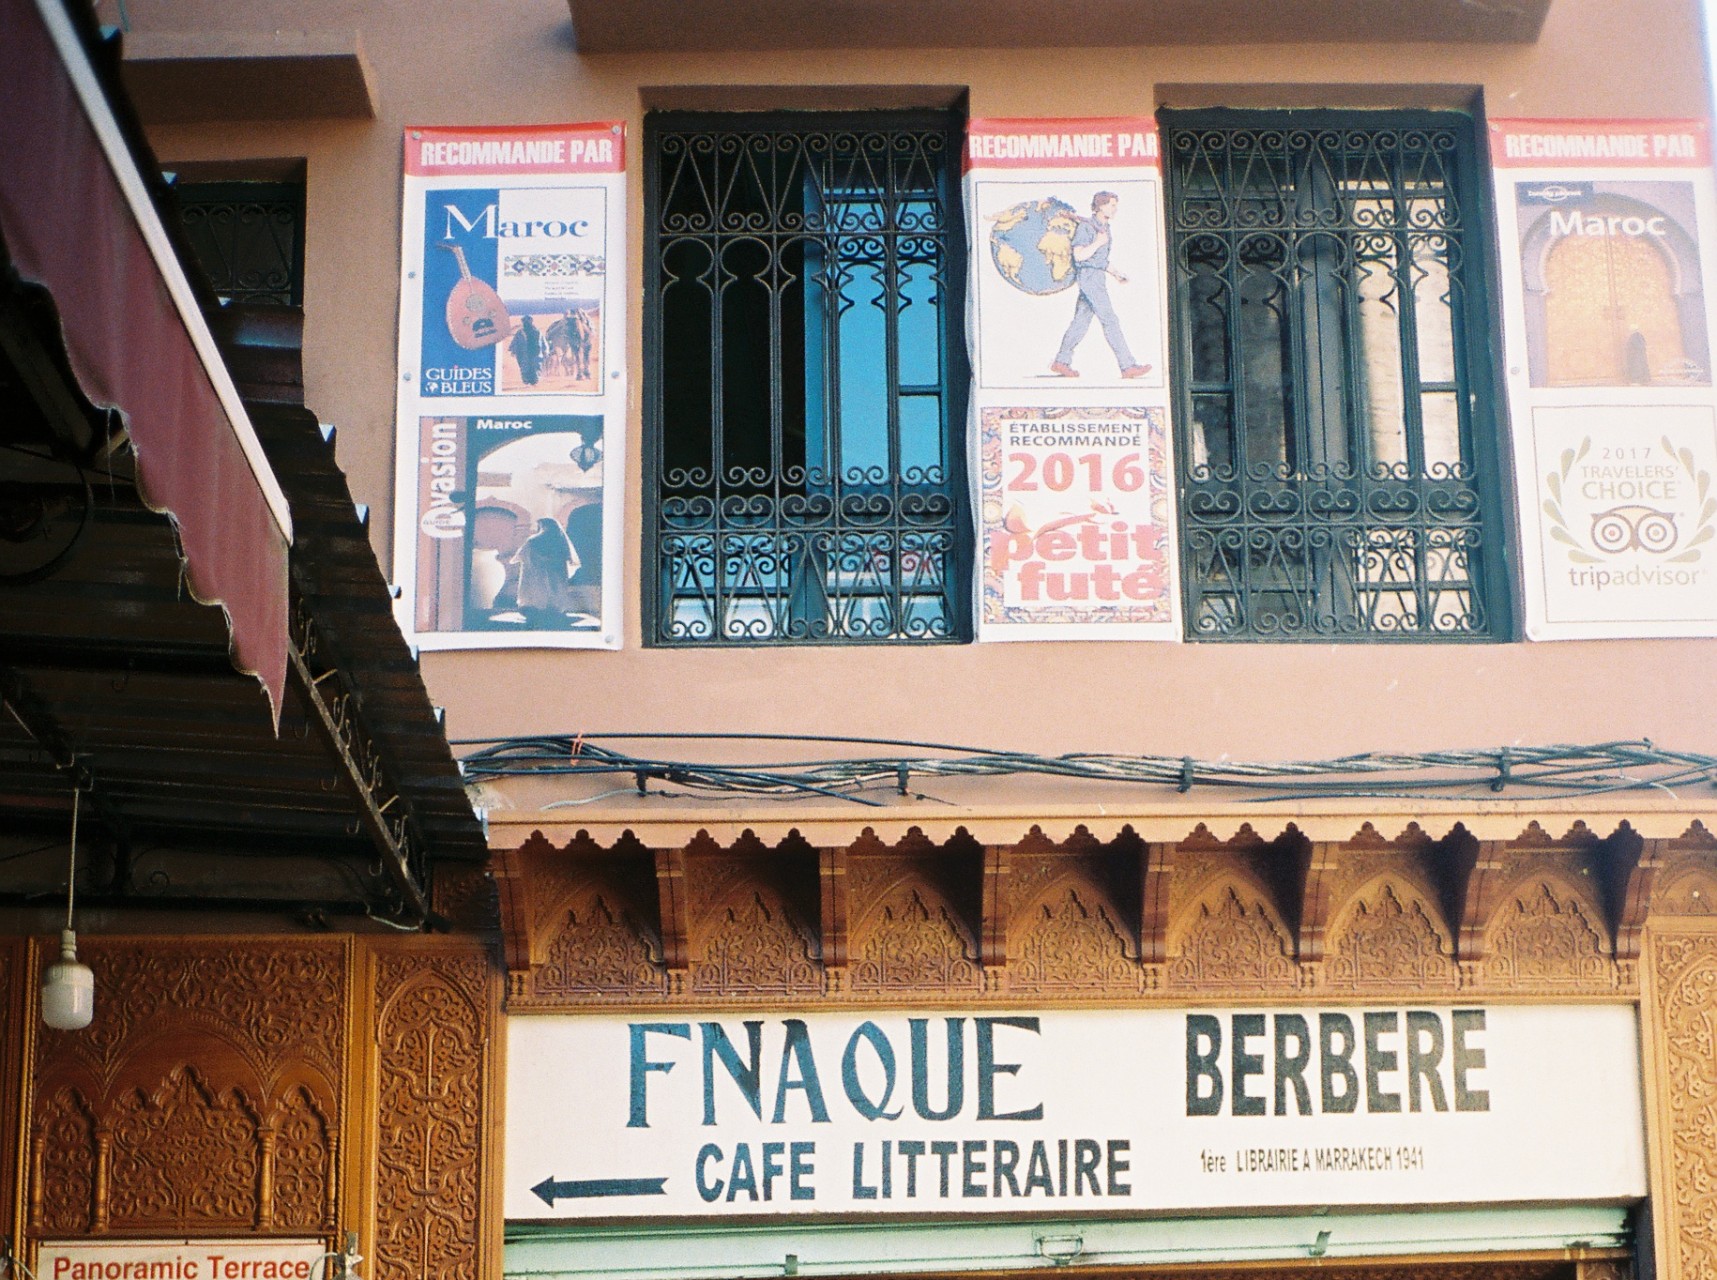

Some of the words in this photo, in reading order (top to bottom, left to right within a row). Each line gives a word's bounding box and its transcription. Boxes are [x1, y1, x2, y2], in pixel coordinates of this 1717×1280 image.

[421, 140, 565, 166] RECOMMANDE
[570, 139, 613, 164] PAR
[969, 134, 1112, 159] RECOMMANDE
[1118, 133, 1158, 157] PAR
[1506, 134, 1649, 158] RECOMMANDE
[1653, 134, 1696, 157] PAR
[443, 204, 589, 239] Maroc
[1550, 211, 1666, 236] Maroc
[425, 366, 492, 381] GUIDES
[441, 381, 492, 394] BLEUS
[476, 419, 533, 430] Maroc
[1009, 422, 1142, 433] ÉTABLISSEMENT
[1010, 435, 1142, 446] RECOMMANDÉ
[1602, 448, 1651, 460] 2017
[1007, 452, 1145, 492] 2016
[1581, 481, 1677, 499] CHOICE
[989, 521, 1162, 570] petit
[1017, 561, 1163, 601] futé
[1568, 565, 1700, 591] tripadvisor
[626, 1016, 1044, 1128] FNAQUE
[1186, 1009, 1491, 1117] BERBERE
[695, 1141, 815, 1202] CAFE
[852, 1139, 1132, 1199] LITTERAIRE
[1201, 1149, 1226, 1172] 1ère
[1236, 1148, 1298, 1172] LIBRAIRIE
[1303, 1149, 1311, 1171] A
[1315, 1147, 1393, 1171] MARRAKECH
[1397, 1147, 1424, 1170] 1941
[53, 1256, 198, 1280] Panoramic
[207, 1255, 310, 1280] Terrace
